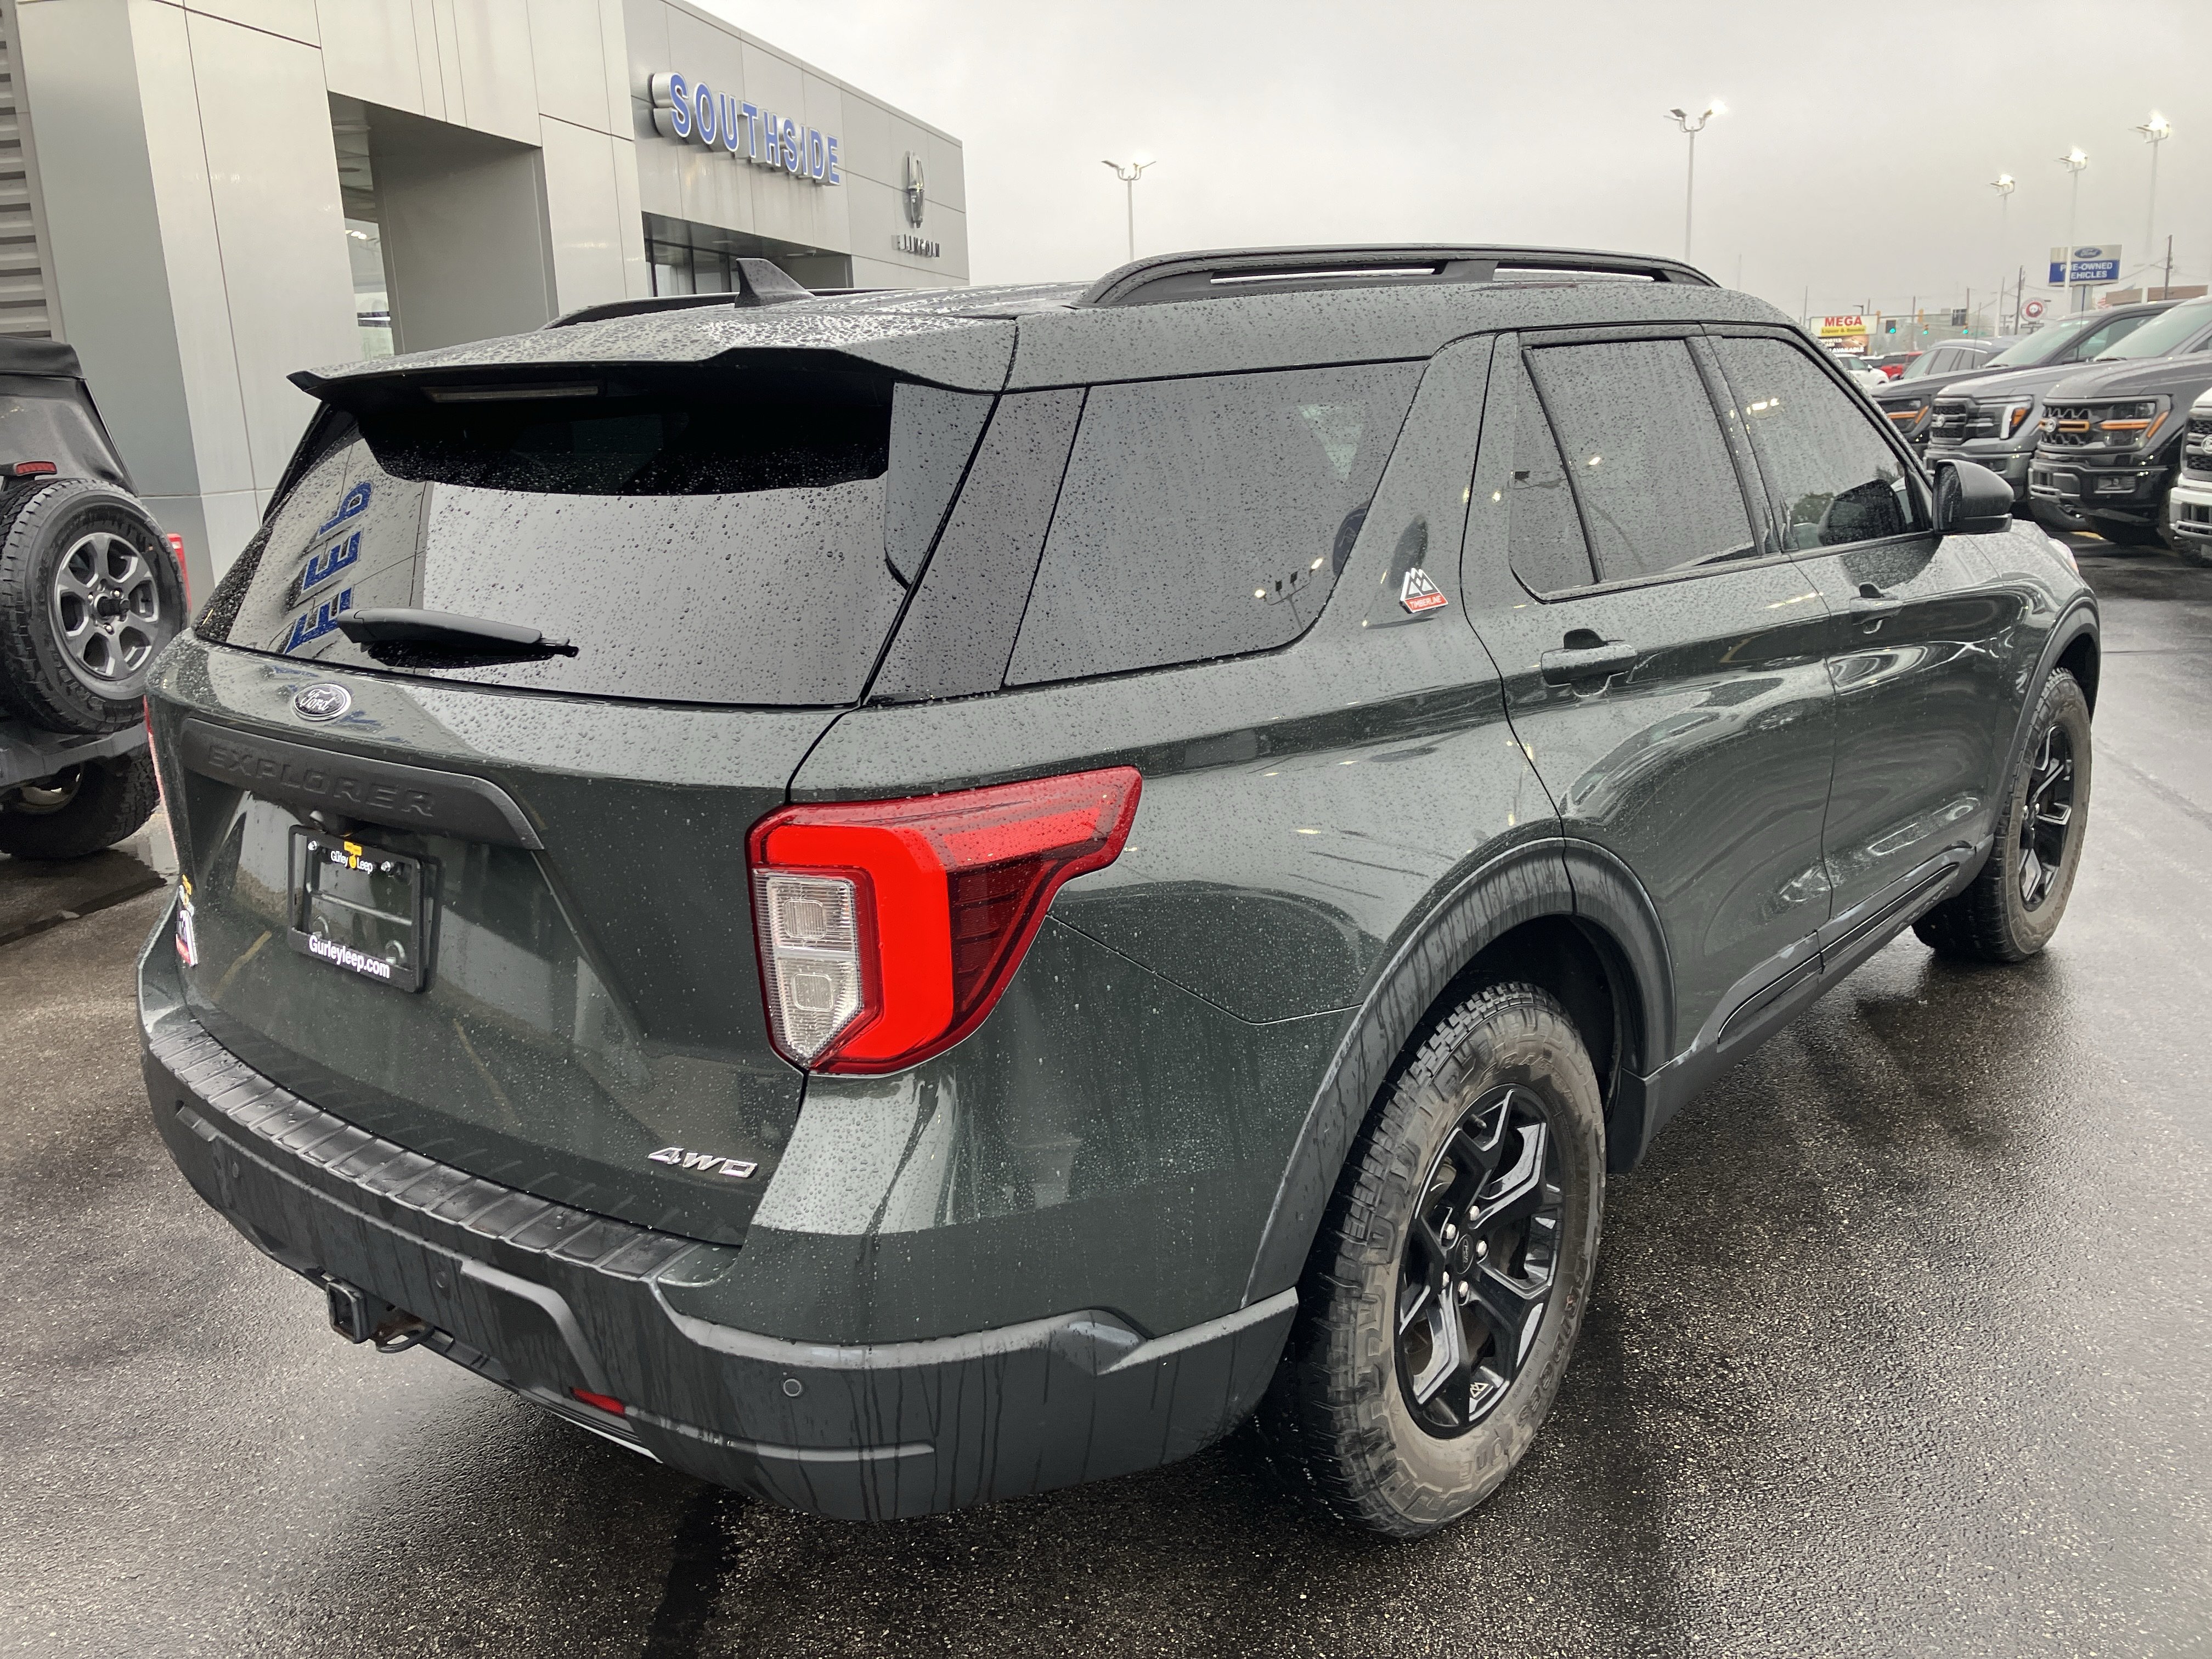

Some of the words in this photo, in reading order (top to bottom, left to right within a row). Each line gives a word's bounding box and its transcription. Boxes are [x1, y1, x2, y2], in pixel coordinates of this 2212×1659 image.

[669, 72, 841, 185] SOUTHSIDE
[2060, 262, 2113, 272] PE-OWNED
[2070, 270, 2108, 279] EHICLES
[1825, 316, 1863, 326] MEGA
[1409, 595, 1442, 608] TIMBERLINE
[299, 689, 336, 711] Ford
[207, 744, 434, 817] EXPLORER
[357, 857, 373, 874] Leep
[309, 935, 390, 979] Gurleyleep.com
[647, 1147, 758, 1178] 4WD
[1459, 1251, 1588, 1480] BRIDGESONE
